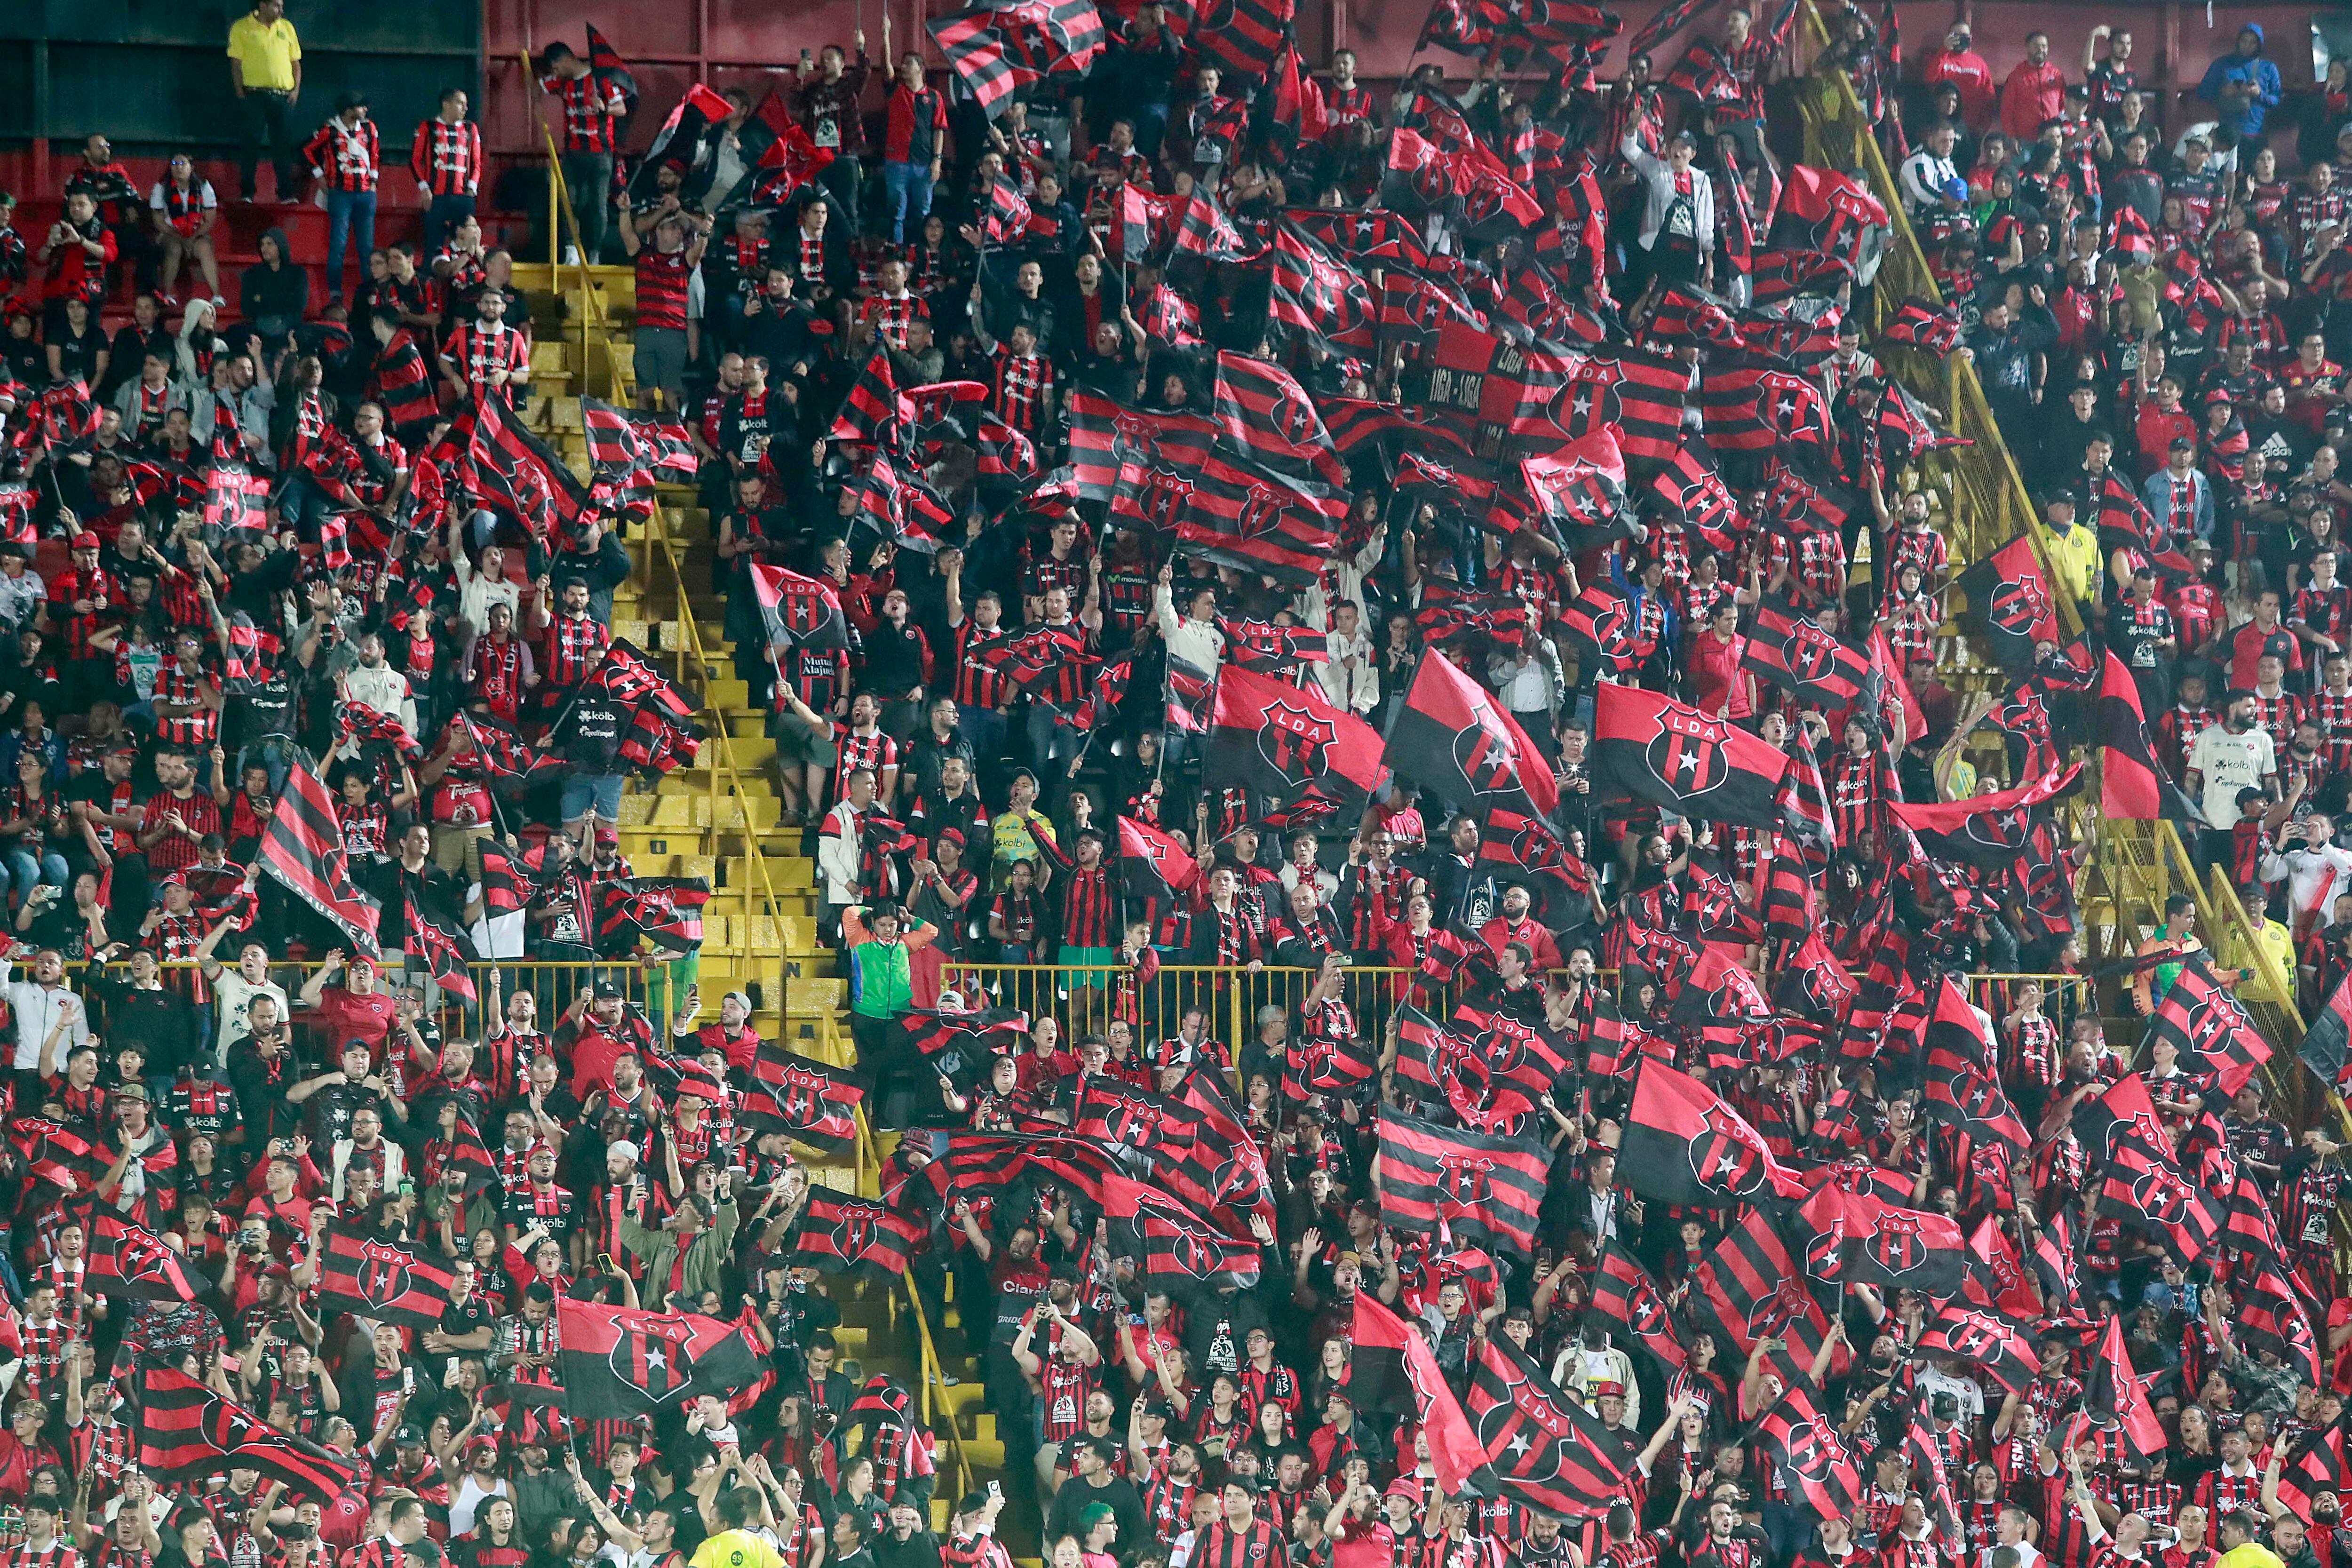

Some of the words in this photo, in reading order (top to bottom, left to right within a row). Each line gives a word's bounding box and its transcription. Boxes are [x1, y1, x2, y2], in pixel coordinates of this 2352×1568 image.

[1573, 368, 1607, 382] LDA
[1289, 388, 1305, 401] LD
[1430, 369, 1451, 403] LIGA
[1458, 375, 1481, 408] LIGA
[1156, 477, 1182, 492] LDA
[1708, 480, 1729, 504] LDA
[2024, 584, 2040, 615] LDA
[1905, 620, 1923, 631] kölb
[2138, 626, 2157, 637] kölbi
[1802, 630, 1829, 646] LDA
[633, 668, 655, 687] LDA
[592, 712, 616, 721] kölb
[1278, 713, 1320, 739] LDA
[1673, 717, 1715, 739] LDA
[1002, 837, 1025, 848] kölbi
[642, 893, 668, 902] LDA
[1712, 884, 1732, 902] LDA
[272, 869, 380, 954] ALAJUELENS
[1653, 935, 1682, 951] LDA
[1729, 977, 1753, 1002] LDA
[1820, 970, 1839, 996] LDA
[2212, 999, 2233, 1023] LDA
[1497, 1021, 1522, 1037] LDA
[1626, 1027, 1641, 1040] DA
[1444, 1039, 1462, 1055] LDA
[791, 1075, 817, 1088] LDA
[25, 1122, 49, 1131] LDA
[196, 1117, 221, 1127] kölbi
[709, 1118, 734, 1129] kölbi
[2245, 1148, 2265, 1159] ölbi
[2158, 1171, 2184, 1194] LDA
[846, 1210, 873, 1218] LDA
[541, 1217, 566, 1228] kölbi
[1883, 1221, 1911, 1232] LDA
[134, 1234, 162, 1255] LDA
[372, 1248, 403, 1265] LDA
[1995, 1261, 2010, 1282] LDA
[630, 1320, 676, 1338] LDA
[1974, 1317, 2002, 1336] LDA
[166, 1335, 196, 1346] kölbi
[39, 1355, 60, 1365] kölb
[1521, 1394, 1557, 1431] LDA
[1814, 1424, 1836, 1455] LDA
[1484, 1504, 1511, 1517] kölbi
[2136, 1505, 2169, 1518] Tropical
[732, 1554, 742, 1563] 99
